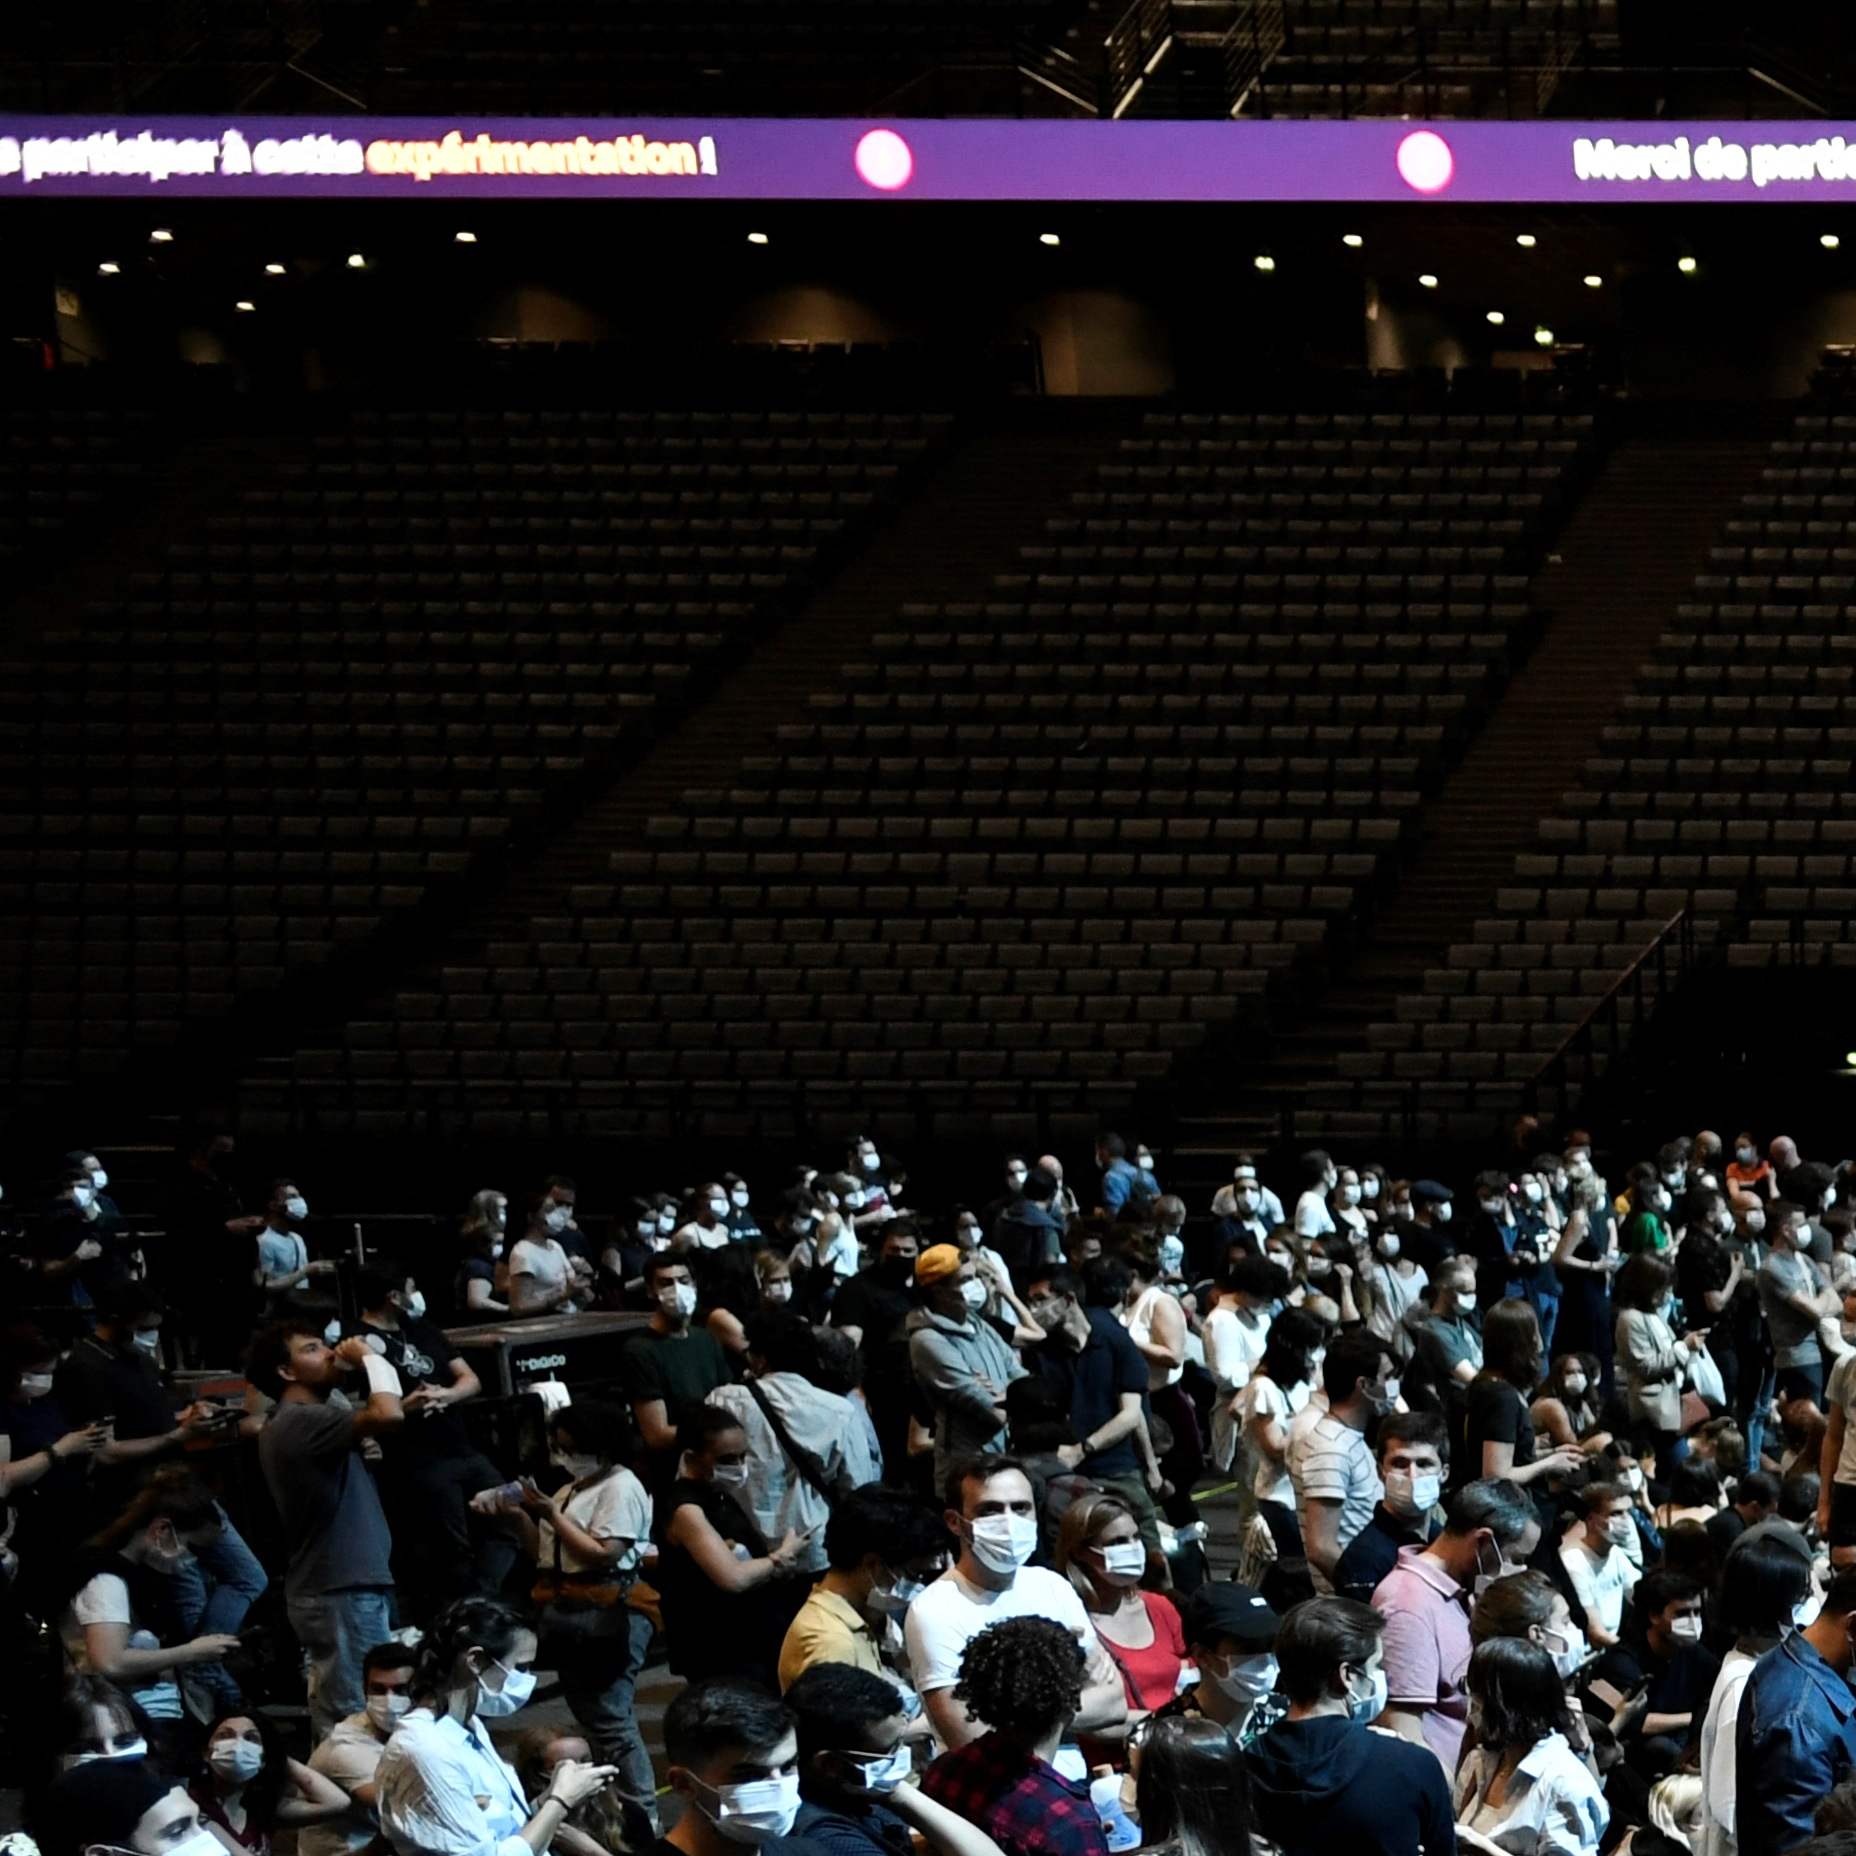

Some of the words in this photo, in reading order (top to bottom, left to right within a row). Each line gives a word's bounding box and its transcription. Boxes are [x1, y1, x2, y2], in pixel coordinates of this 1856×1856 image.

[22, 131, 219, 181] participer
[220, 129, 252, 174] à
[252, 134, 365, 174] cette
[366, 131, 698, 180] expérimentation
[1573, 137, 1692, 180] Merci
[1693, 137, 1749, 180] de
